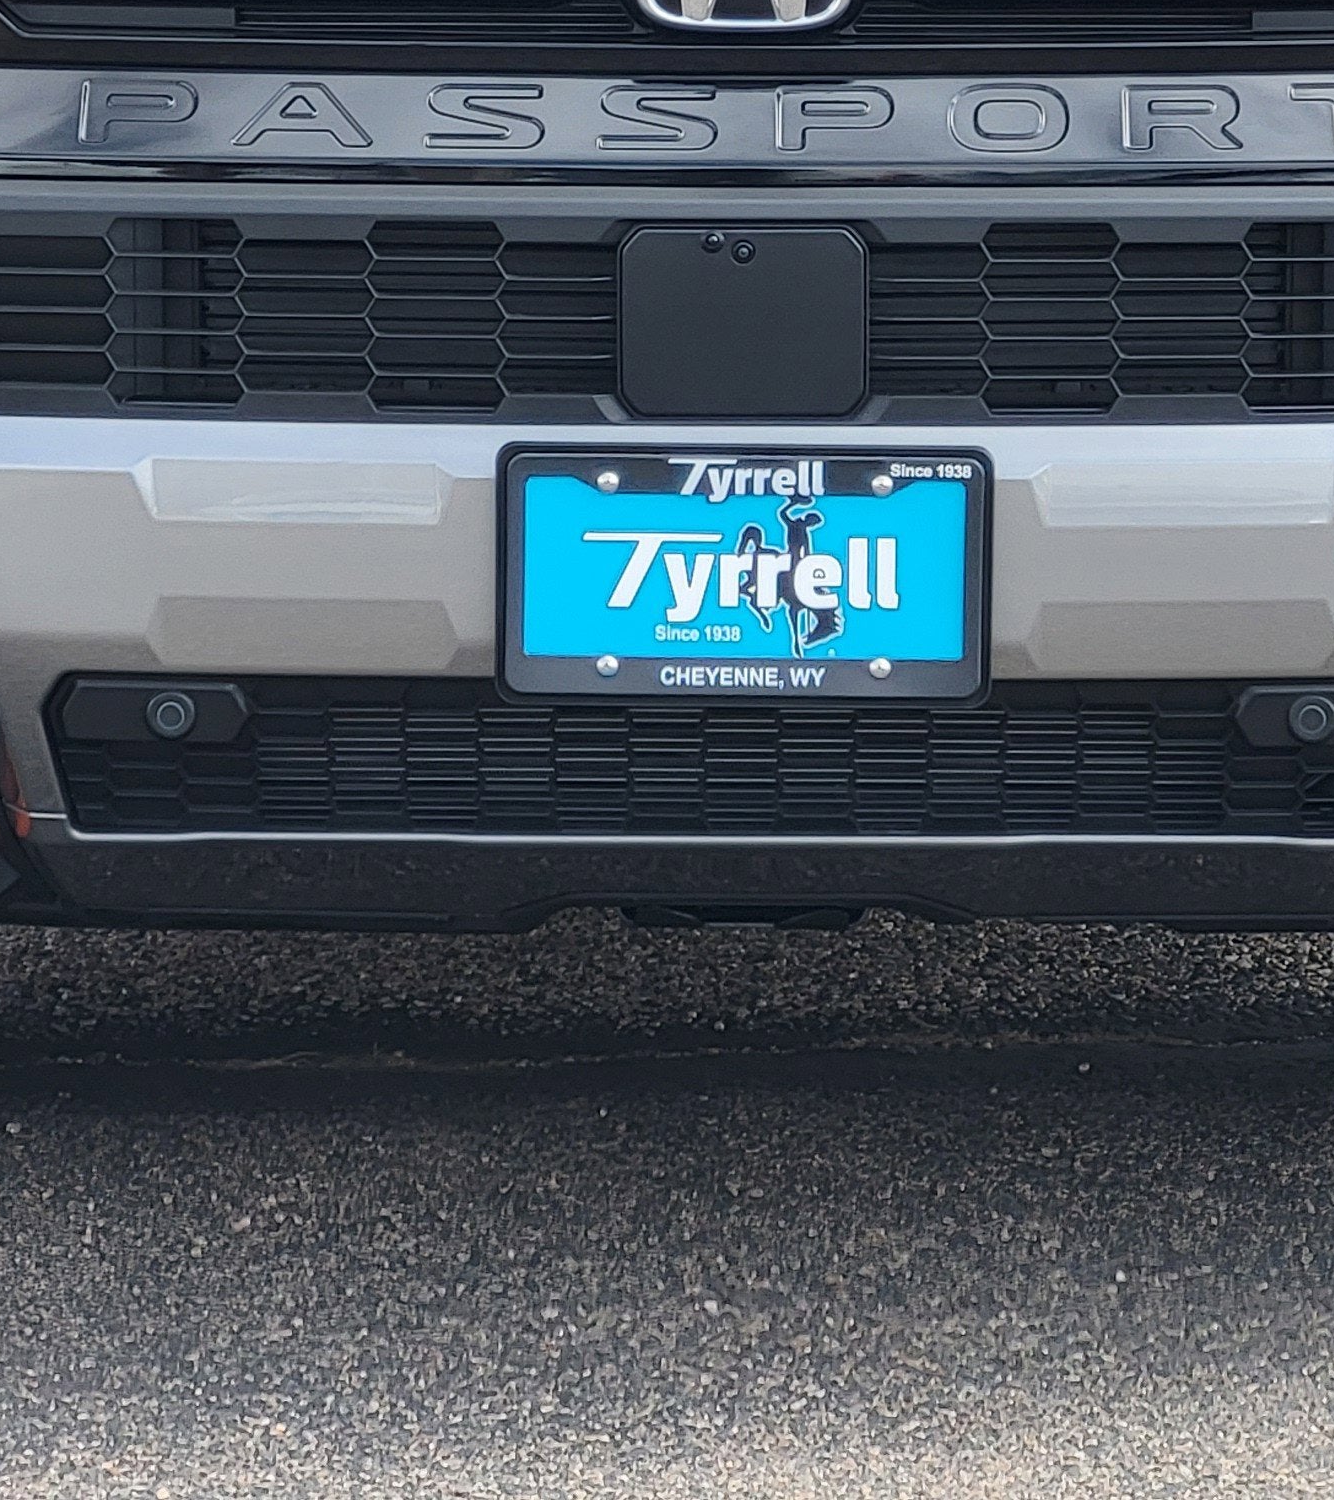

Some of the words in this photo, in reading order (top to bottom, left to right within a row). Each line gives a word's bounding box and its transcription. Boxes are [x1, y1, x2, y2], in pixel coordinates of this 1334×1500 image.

[667, 458, 825, 503] Tyrrell
[889, 463, 933, 479] Since
[936, 463, 973, 480] 1938
[582, 531, 901, 623] Tyrrell
[654, 624, 699, 642] Since
[703, 624, 742, 642] 1938
[660, 666, 785, 690] CHEYENNE,
[789, 667, 827, 688] WY
